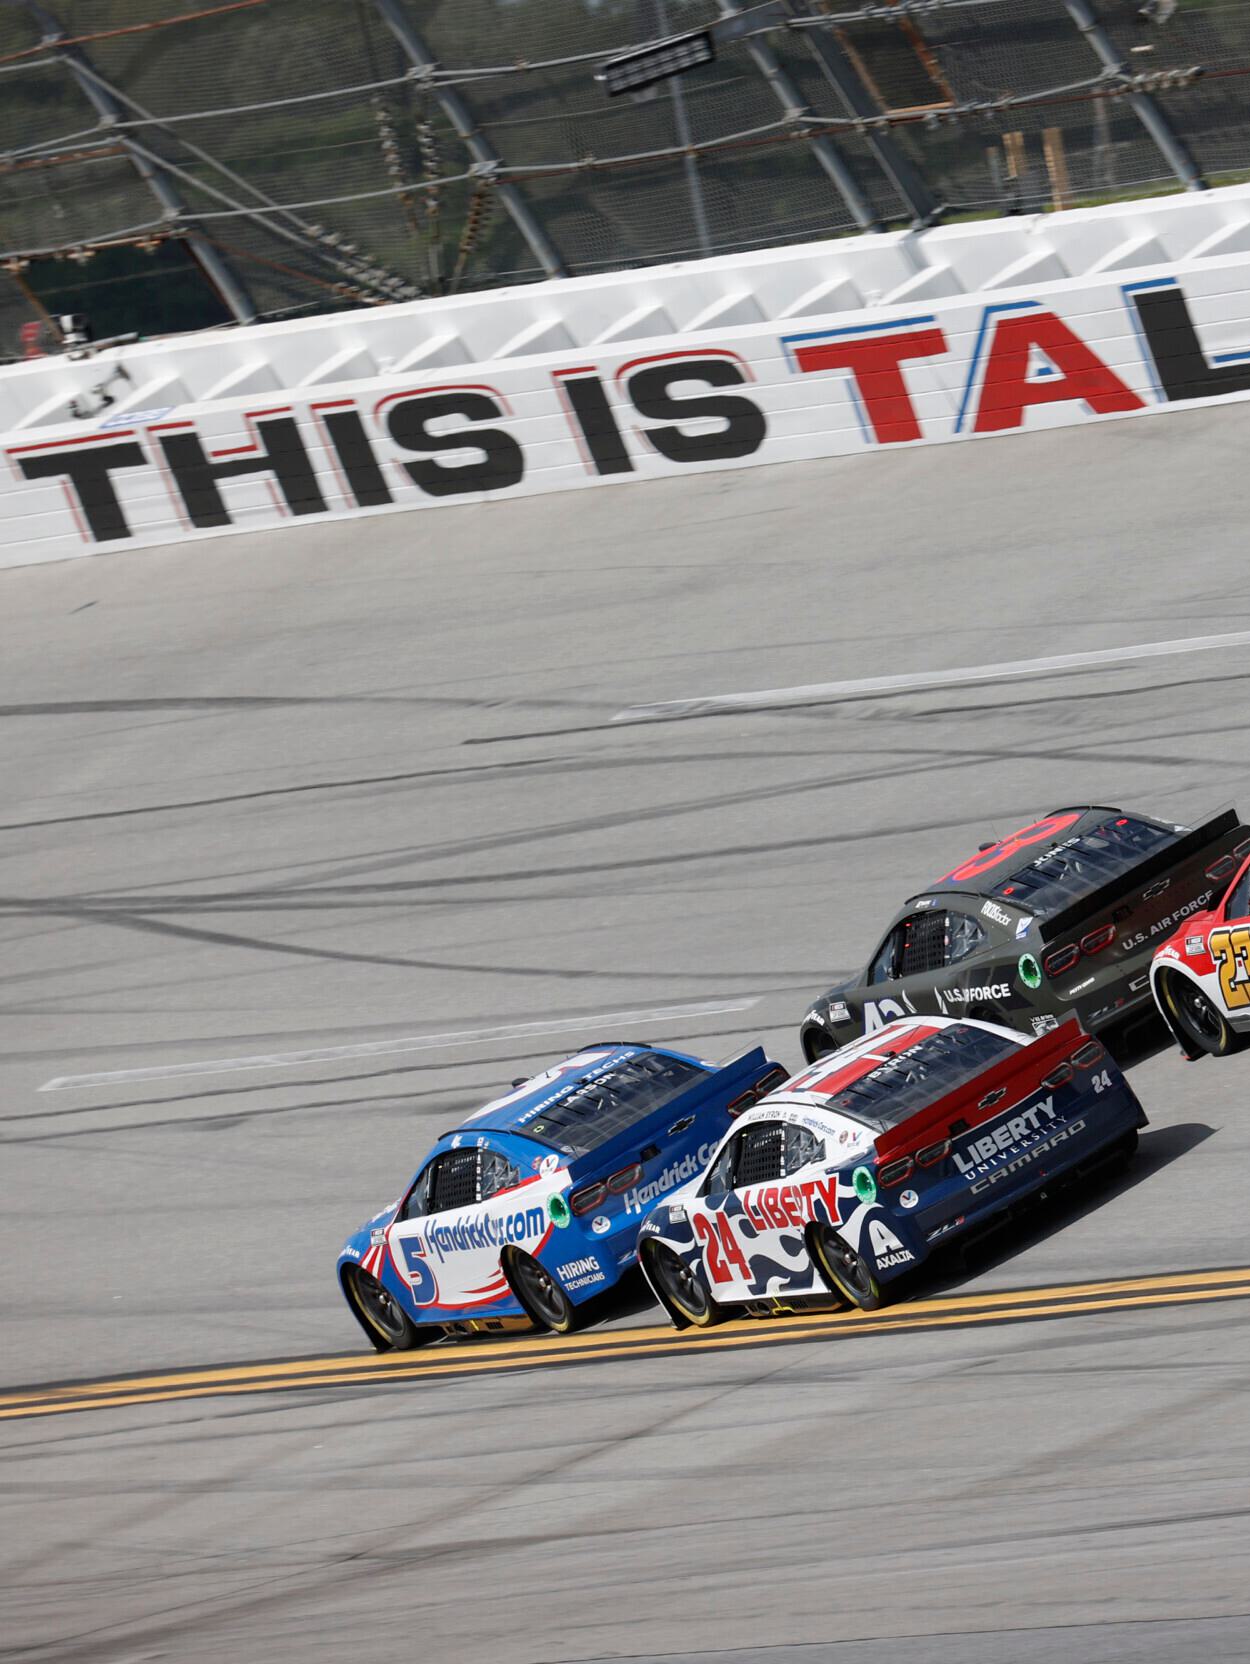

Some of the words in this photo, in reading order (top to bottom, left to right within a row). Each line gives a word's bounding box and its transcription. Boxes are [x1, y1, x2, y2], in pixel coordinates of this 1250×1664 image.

[6, 384, 525, 542] THIS
[552, 347, 767, 476] IS
[1122, 933, 1149, 951] U.S.
[1150, 917, 1173, 938] AIR
[518, 1085, 574, 1123] HIRING
[583, 1051, 635, 1079] TECHS
[1091, 1070, 1113, 1094] 24
[952, 1096, 1057, 1174] LIBERTY
[965, 1115, 1068, 1180] UNIVERSITY
[970, 1119, 1086, 1195] CAMARO
[398, 1234, 438, 1304] 5
[556, 1256, 600, 1281] HIRING
[693, 1211, 753, 1284] 24
[876, 1250, 915, 1270] AXALTA
